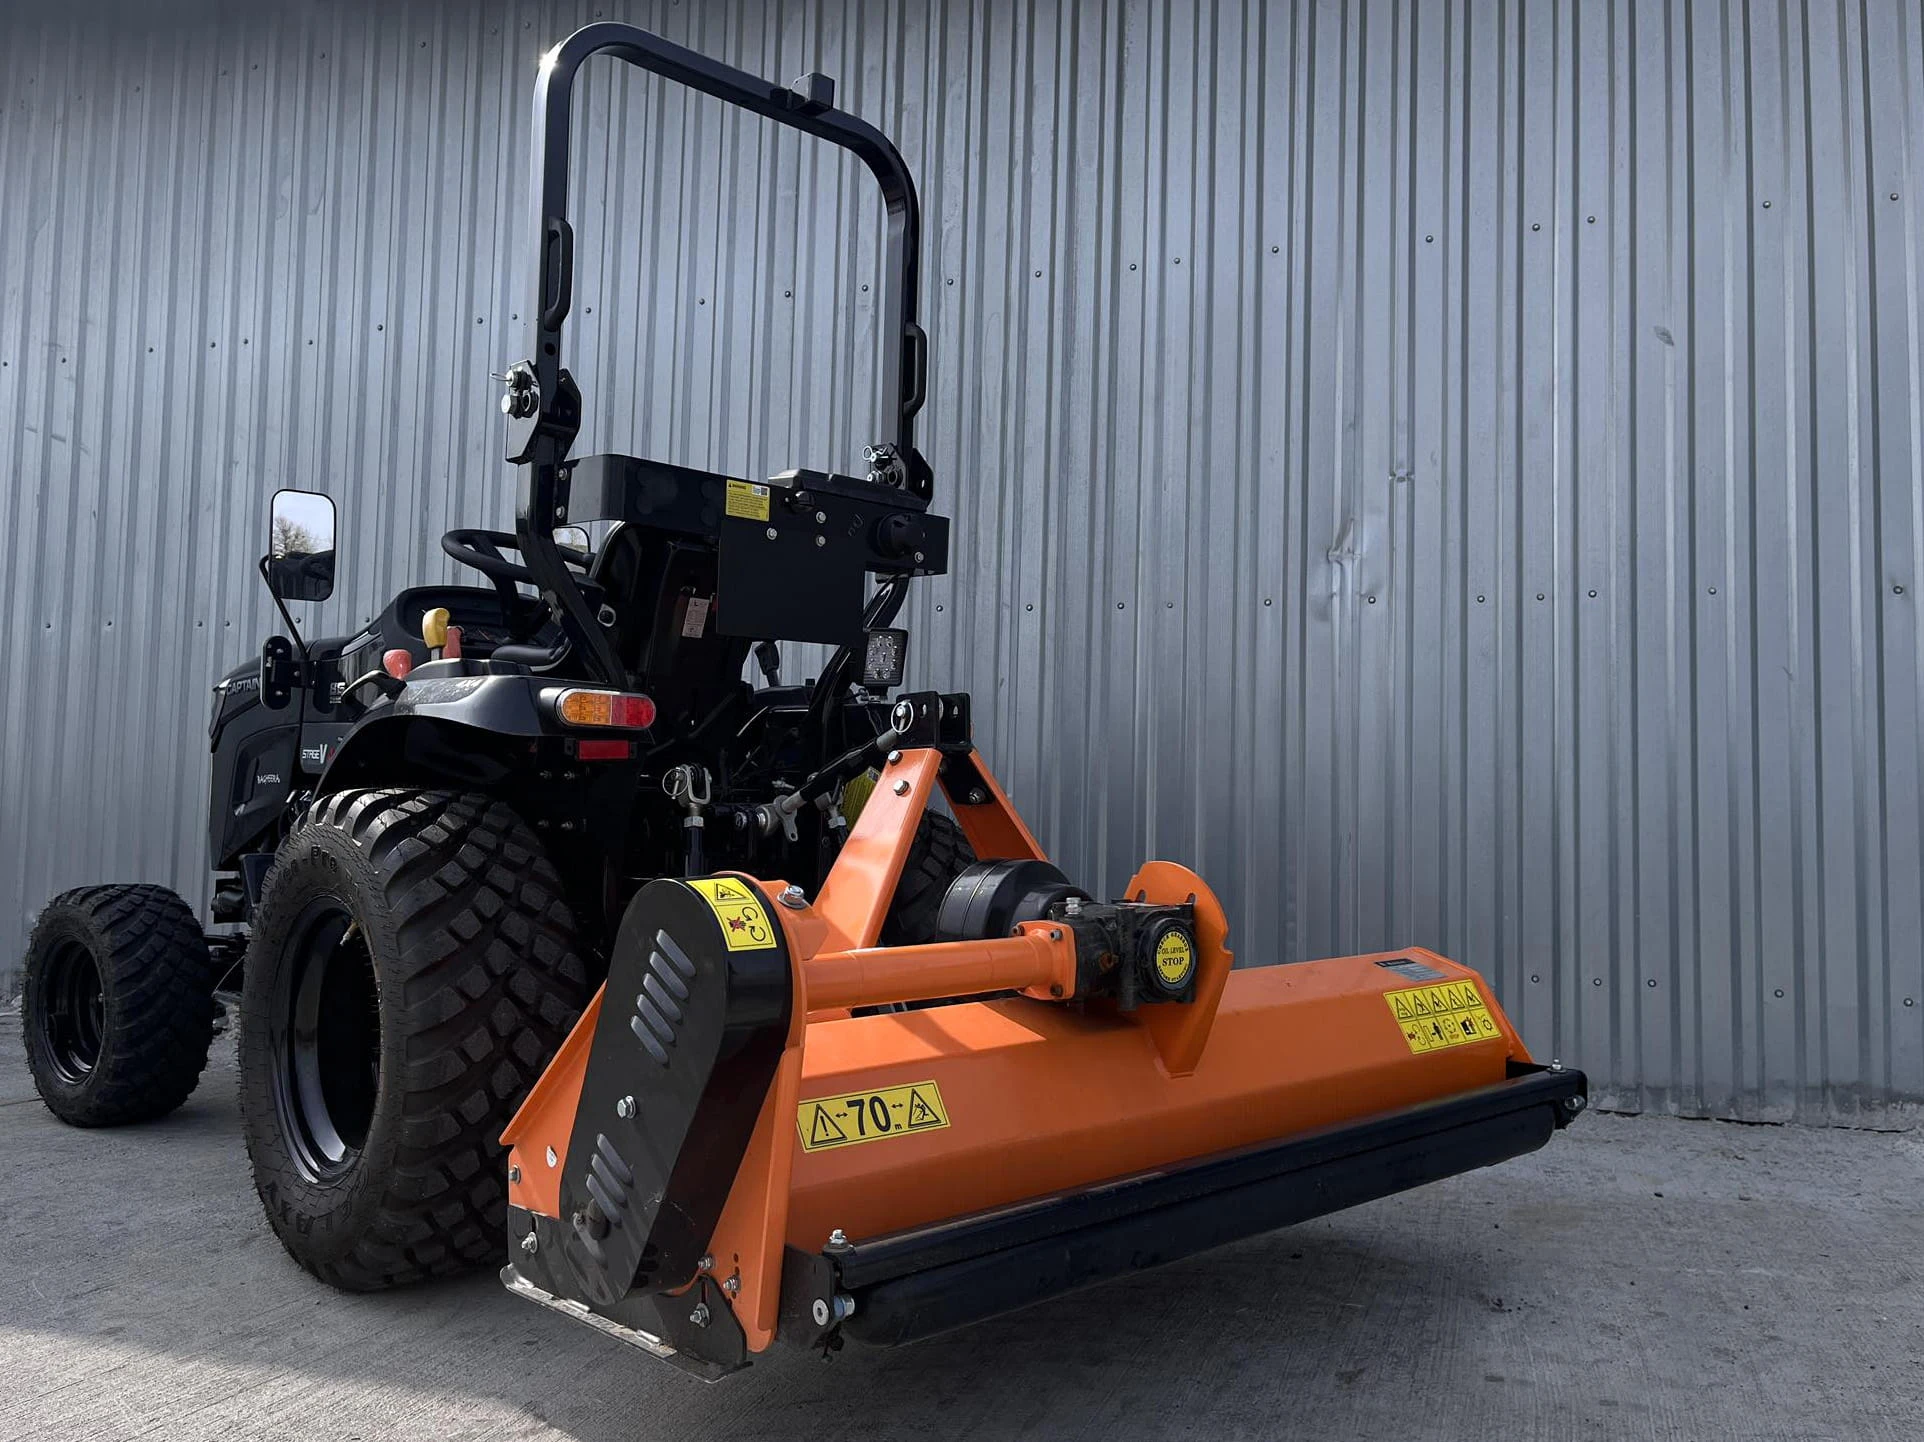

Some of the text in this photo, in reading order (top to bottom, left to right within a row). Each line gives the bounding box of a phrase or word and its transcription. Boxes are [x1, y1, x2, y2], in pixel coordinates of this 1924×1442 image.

[226, 677, 260, 695] CAPTAIN
[302, 743, 328, 765] STAGE V
[1162, 957, 1185, 967] STOP
[846, 1095, 891, 1136] 70
